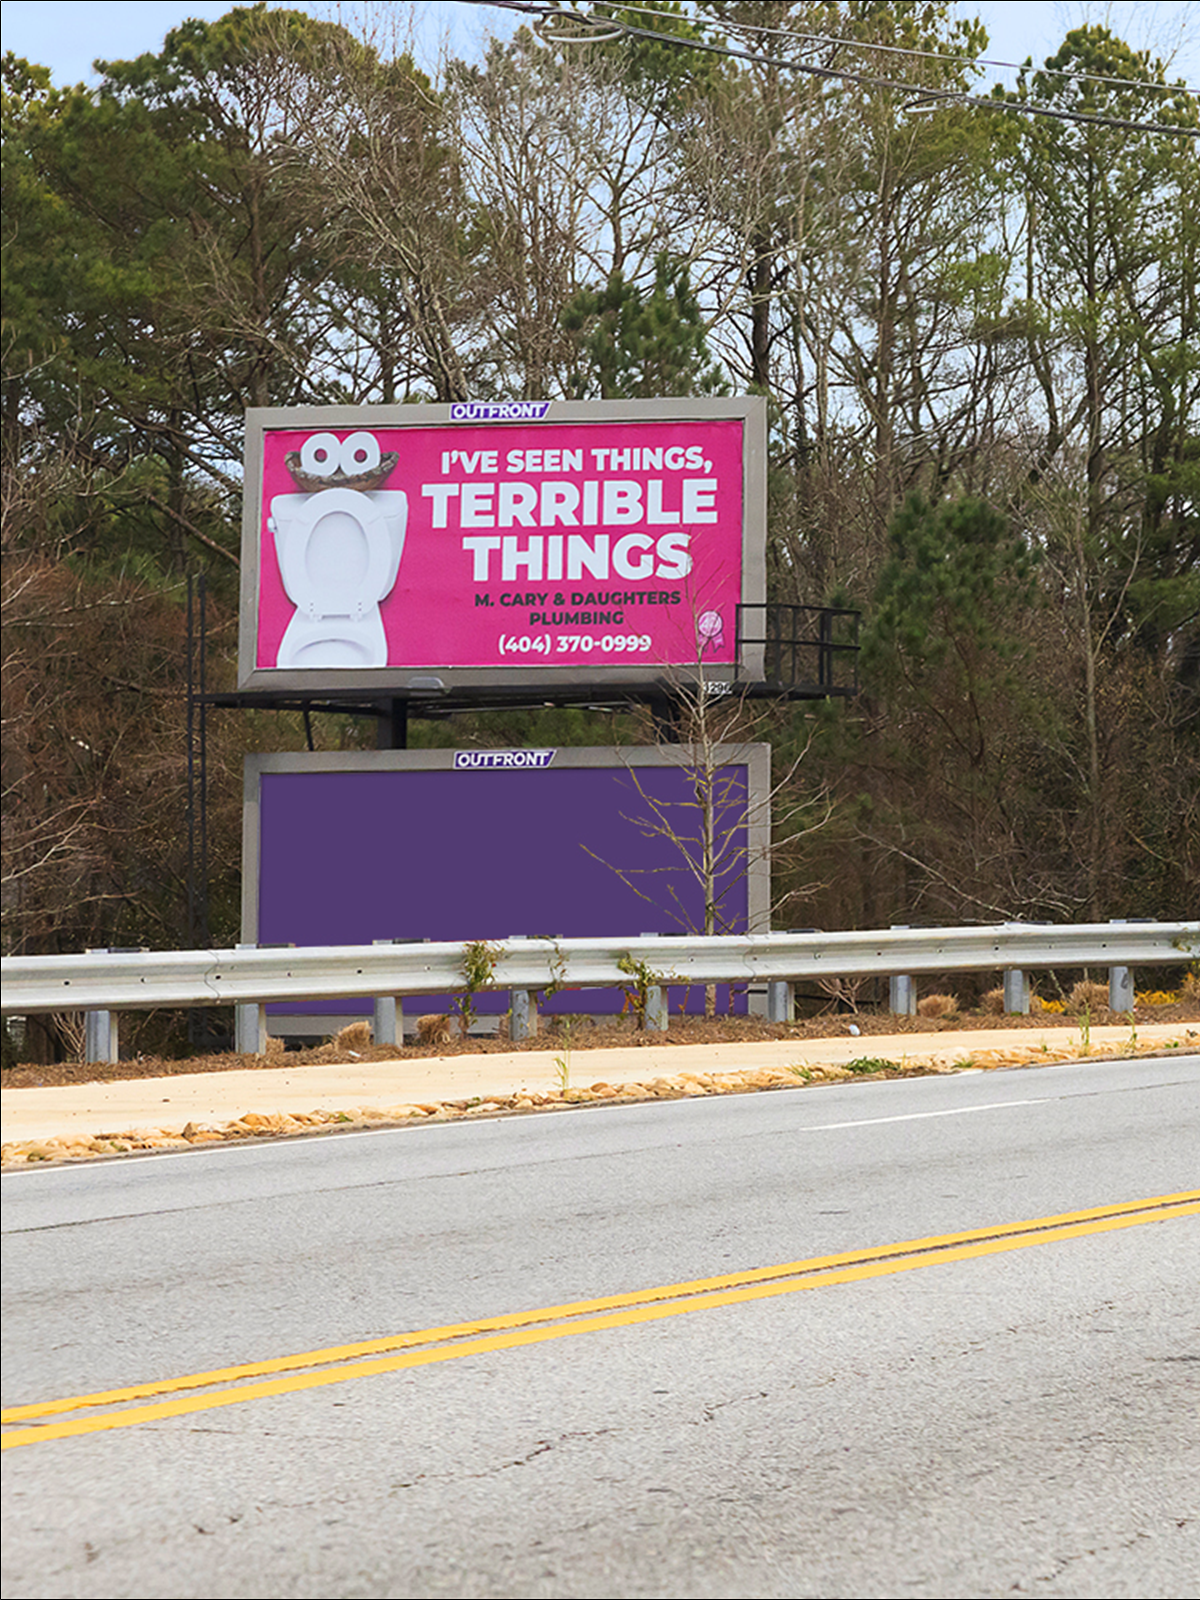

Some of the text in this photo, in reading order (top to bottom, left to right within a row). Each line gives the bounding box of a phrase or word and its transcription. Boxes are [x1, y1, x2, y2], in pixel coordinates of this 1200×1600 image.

[453, 403, 545, 418] OUTFRONT
[441, 446, 713, 474] I’VE SEEN THINGS,
[421, 478, 718, 528] TERRIBLE
[462, 532, 694, 581] THINGS
[474, 591, 682, 607] M. CARY & DAUGHTERS
[529, 611, 624, 626] PLUMBING
[498, 633, 652, 656] (404) 370-0999
[458, 752, 550, 767] OUTFRONT
